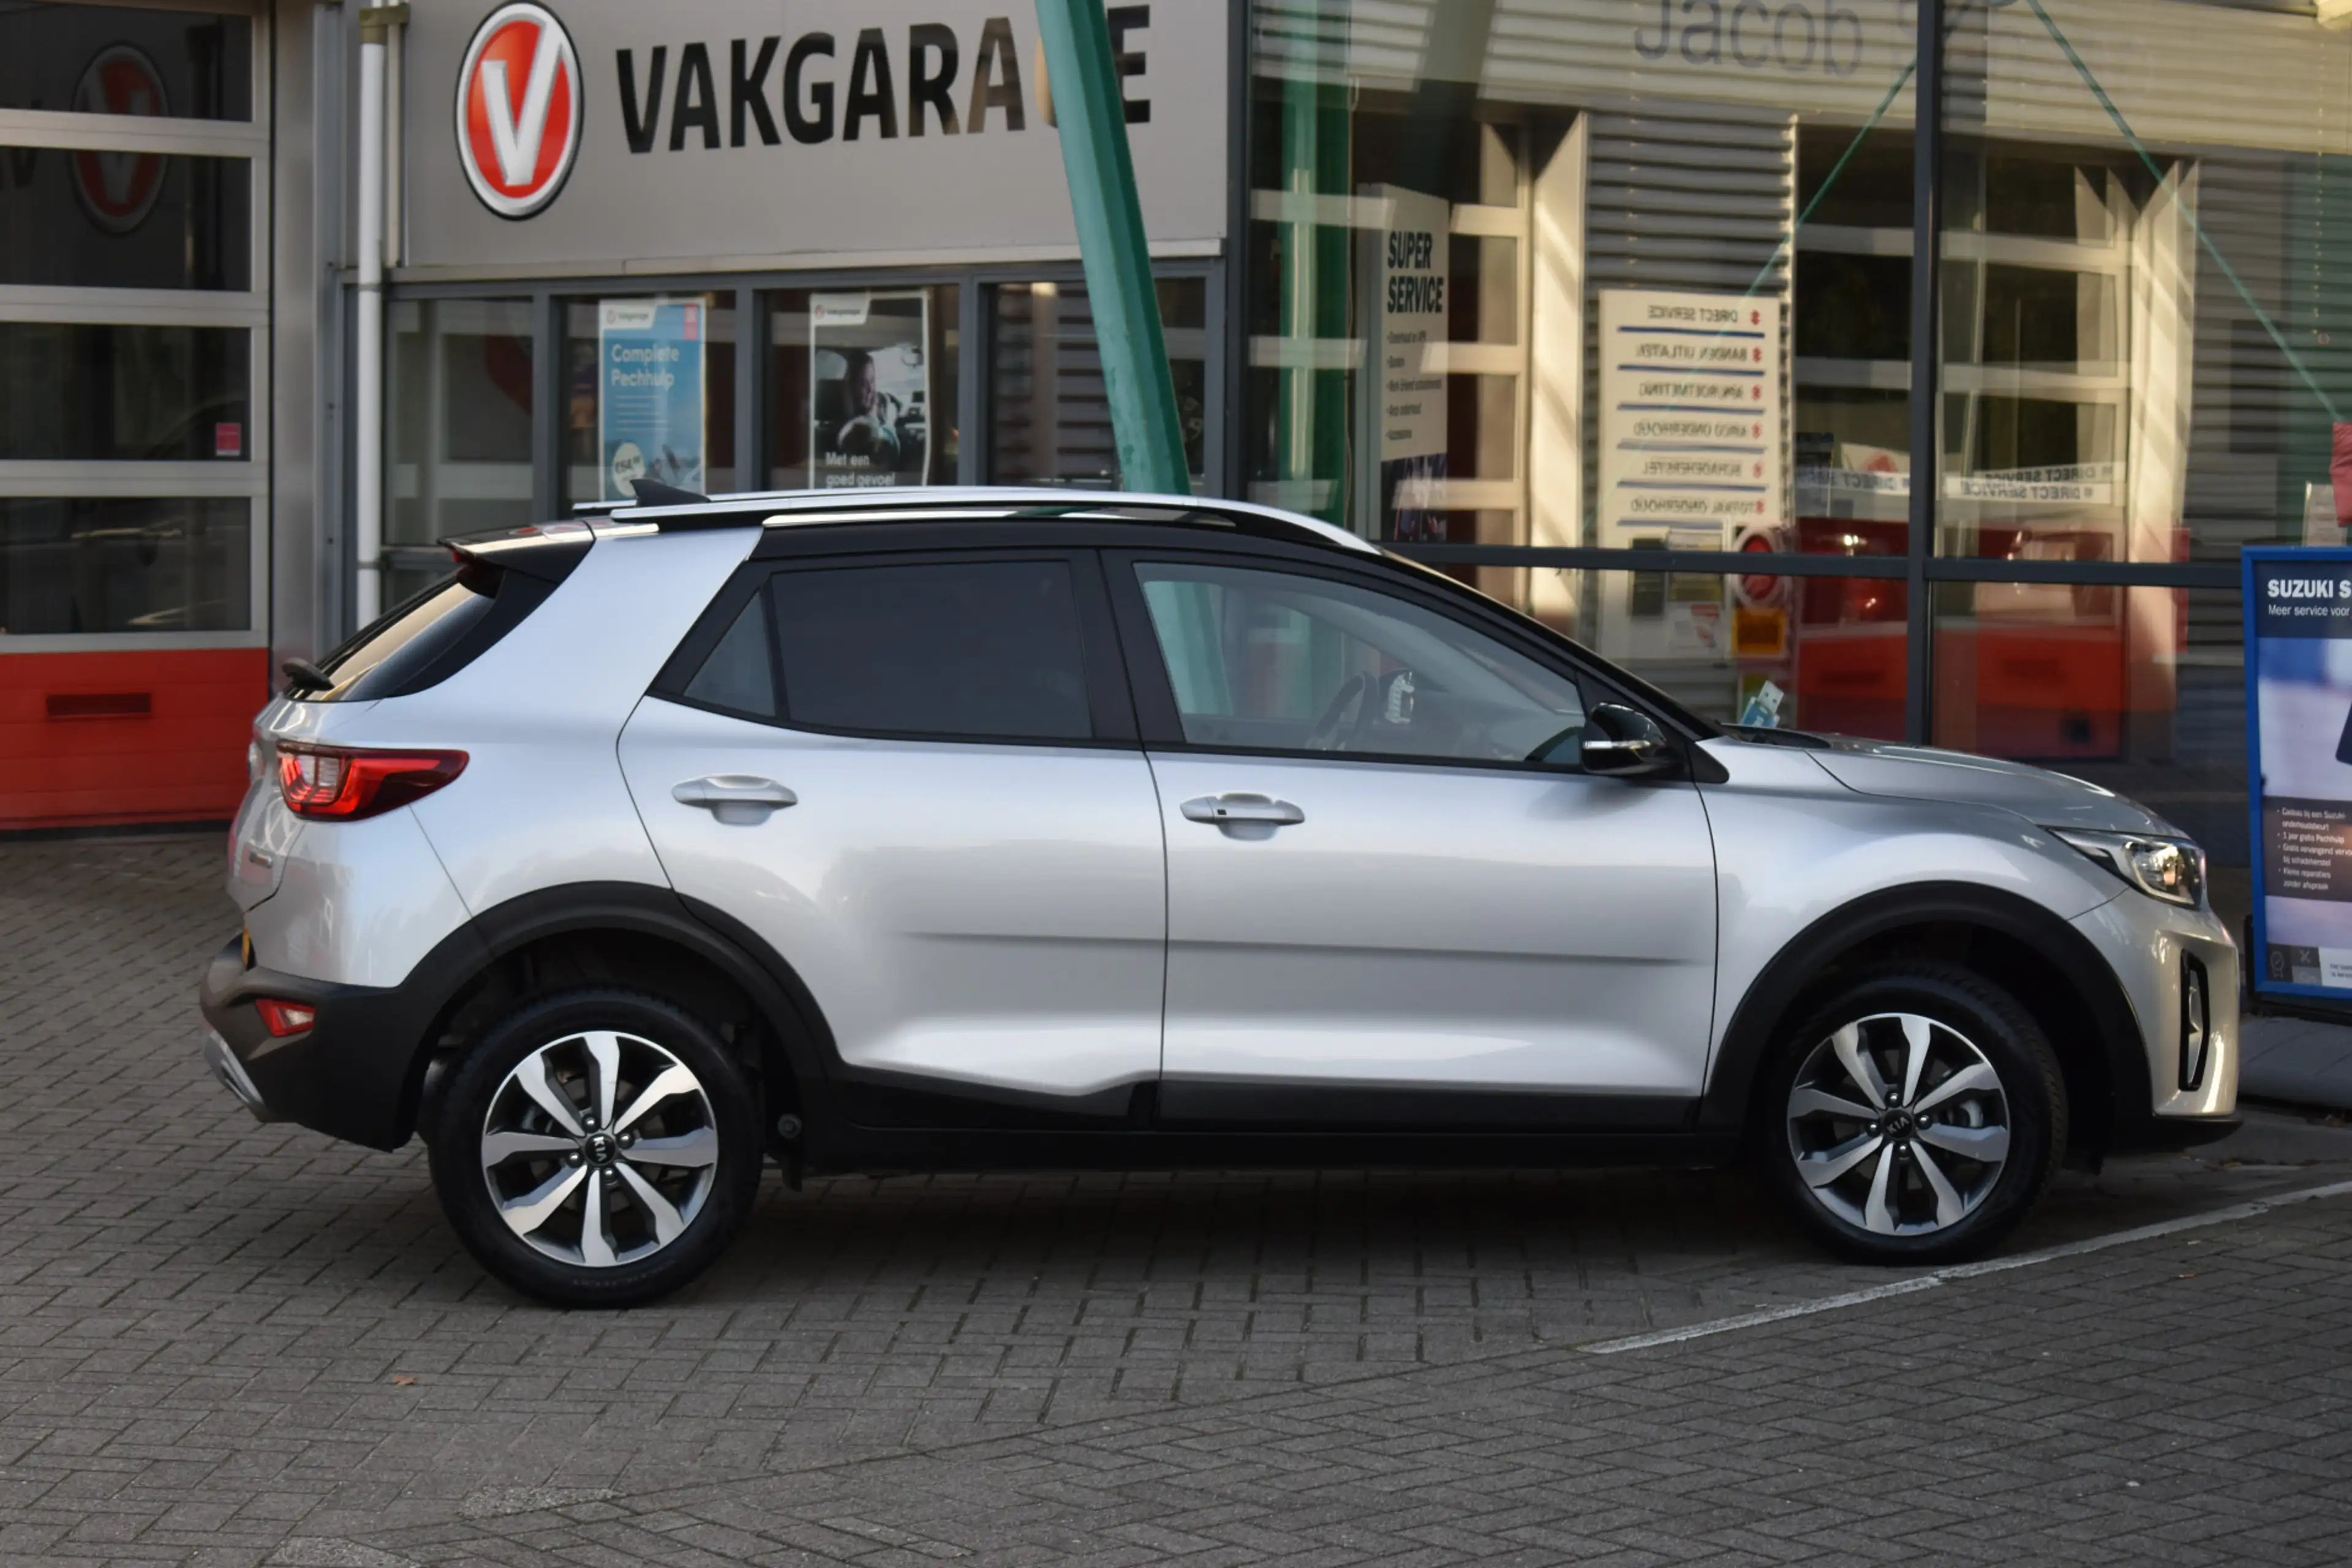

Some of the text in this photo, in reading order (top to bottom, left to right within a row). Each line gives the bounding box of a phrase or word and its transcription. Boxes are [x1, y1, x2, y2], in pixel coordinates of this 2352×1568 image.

[615, 4, 1150, 154] VAKGARAE
[1387, 231, 1433, 270] SUPER
[1387, 276, 1444, 314] SERVICE
[611, 343, 680, 366] Complete
[611, 368, 676, 391] Pechhulp
[826, 451, 870, 467] Met een
[826, 471, 896, 489] goed gevoel
[2267, 579, 2334, 598] SUZUKI
[2268, 604, 2350, 617] Meer service voor
[1886, 1117, 1910, 1134] KIA
[592, 1136, 608, 1162] KIA
